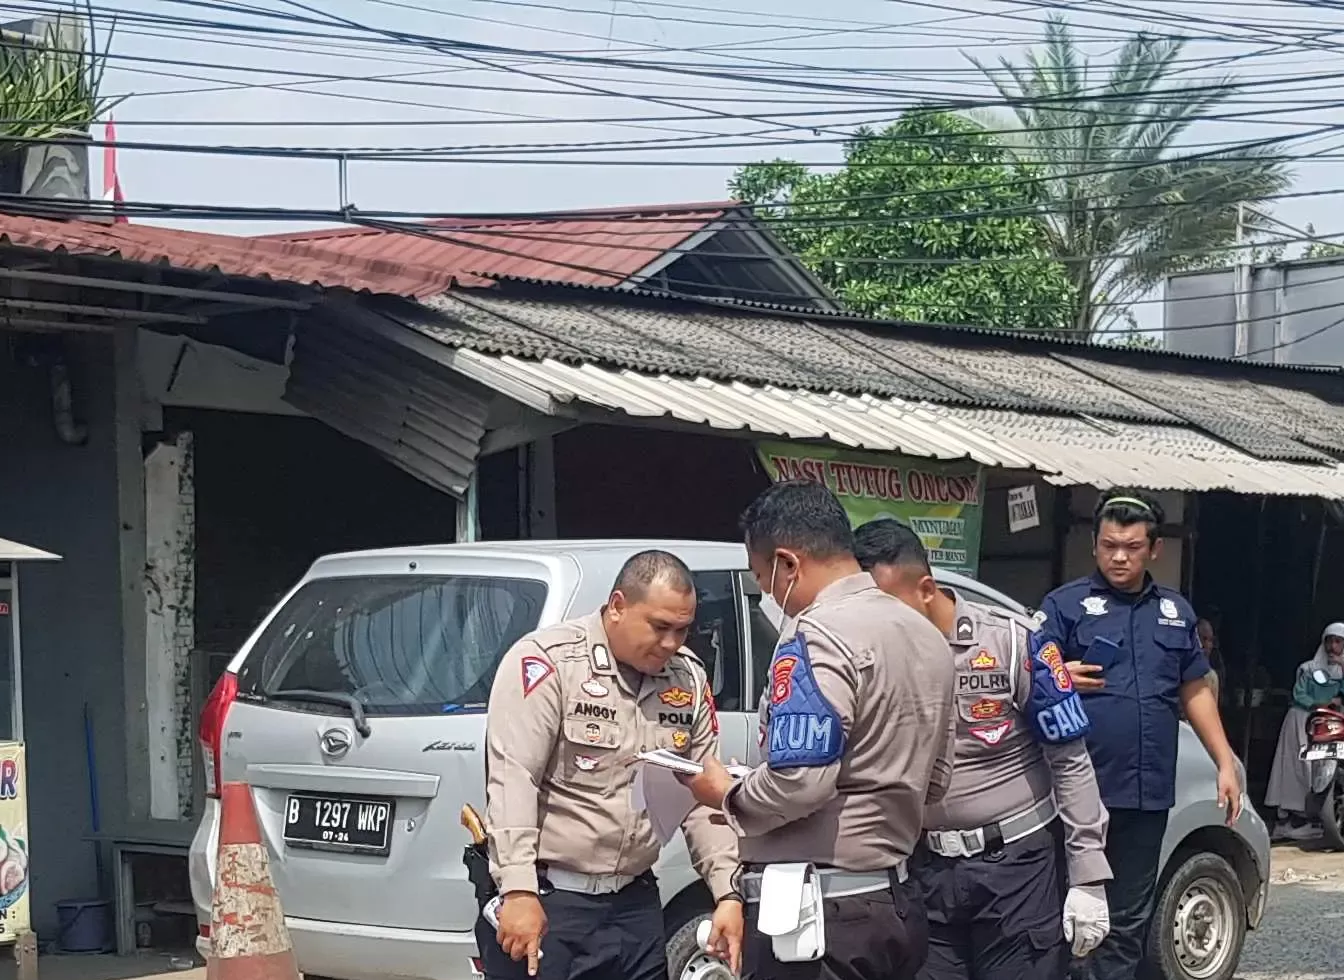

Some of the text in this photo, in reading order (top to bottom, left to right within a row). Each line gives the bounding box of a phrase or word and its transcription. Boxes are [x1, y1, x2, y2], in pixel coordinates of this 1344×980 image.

[828, 460, 904, 501] TUTUG
[288, 798, 387, 832] B 1297 WKP
